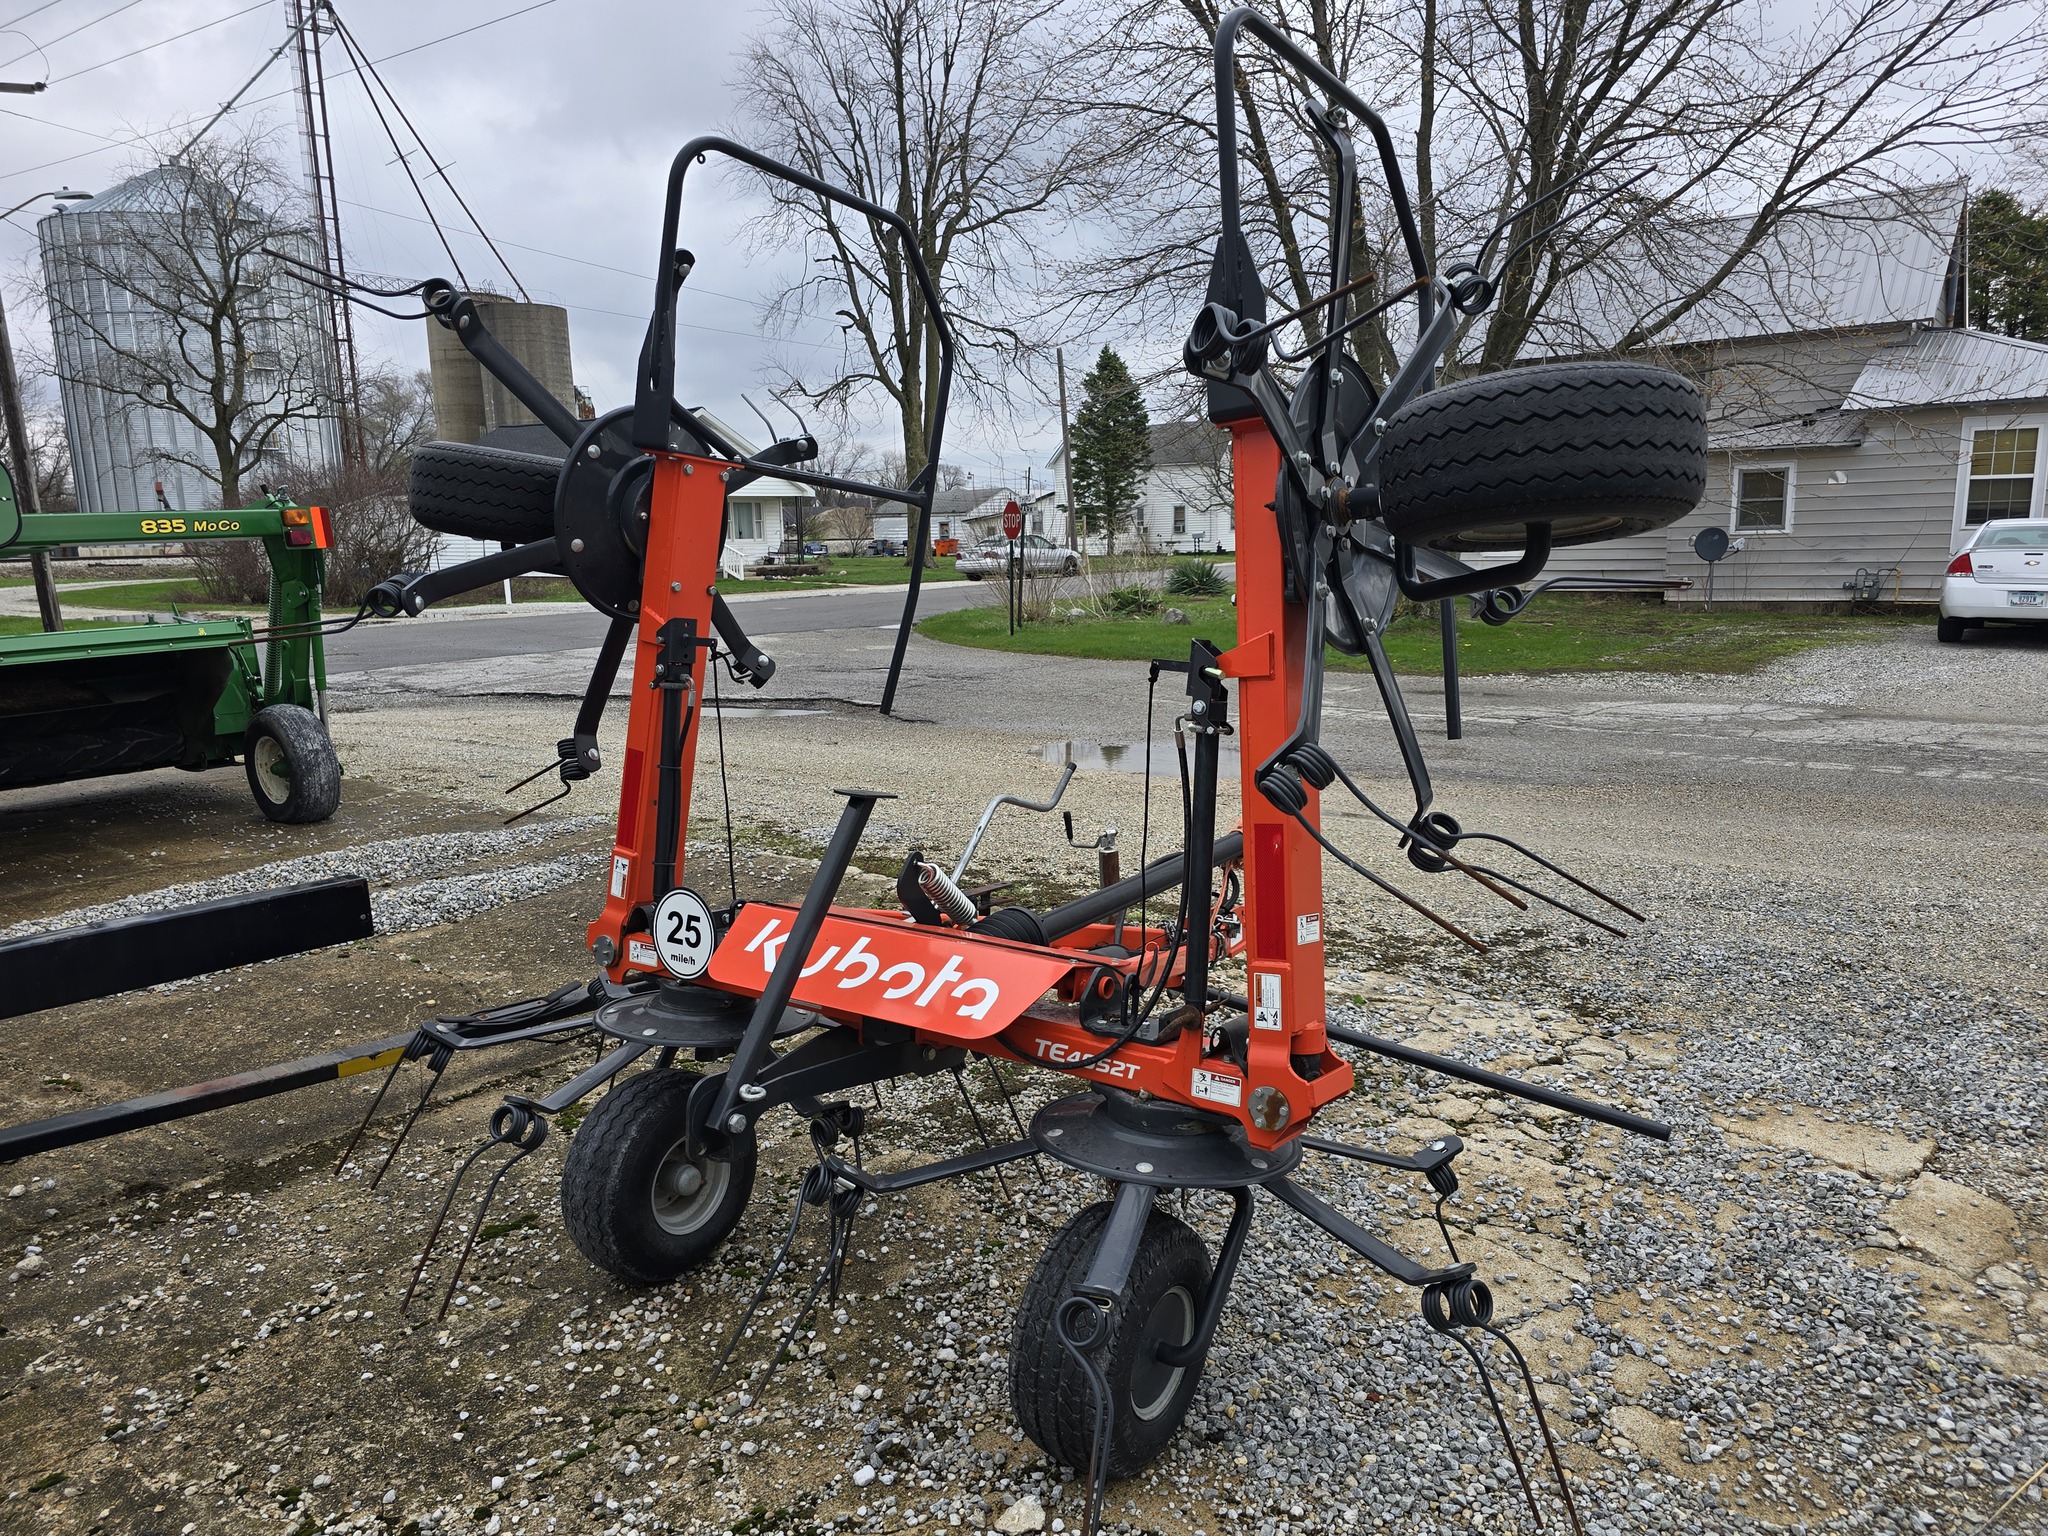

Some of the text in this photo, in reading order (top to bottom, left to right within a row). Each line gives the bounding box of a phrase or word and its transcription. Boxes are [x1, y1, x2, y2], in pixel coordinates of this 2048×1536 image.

[140, 518, 241, 534] 835 MoCo
[1003, 513, 1021, 528] STOP
[666, 910, 701, 949] 25
[670, 953, 696, 966] mile/h
[744, 918, 1000, 1021] Kubota
